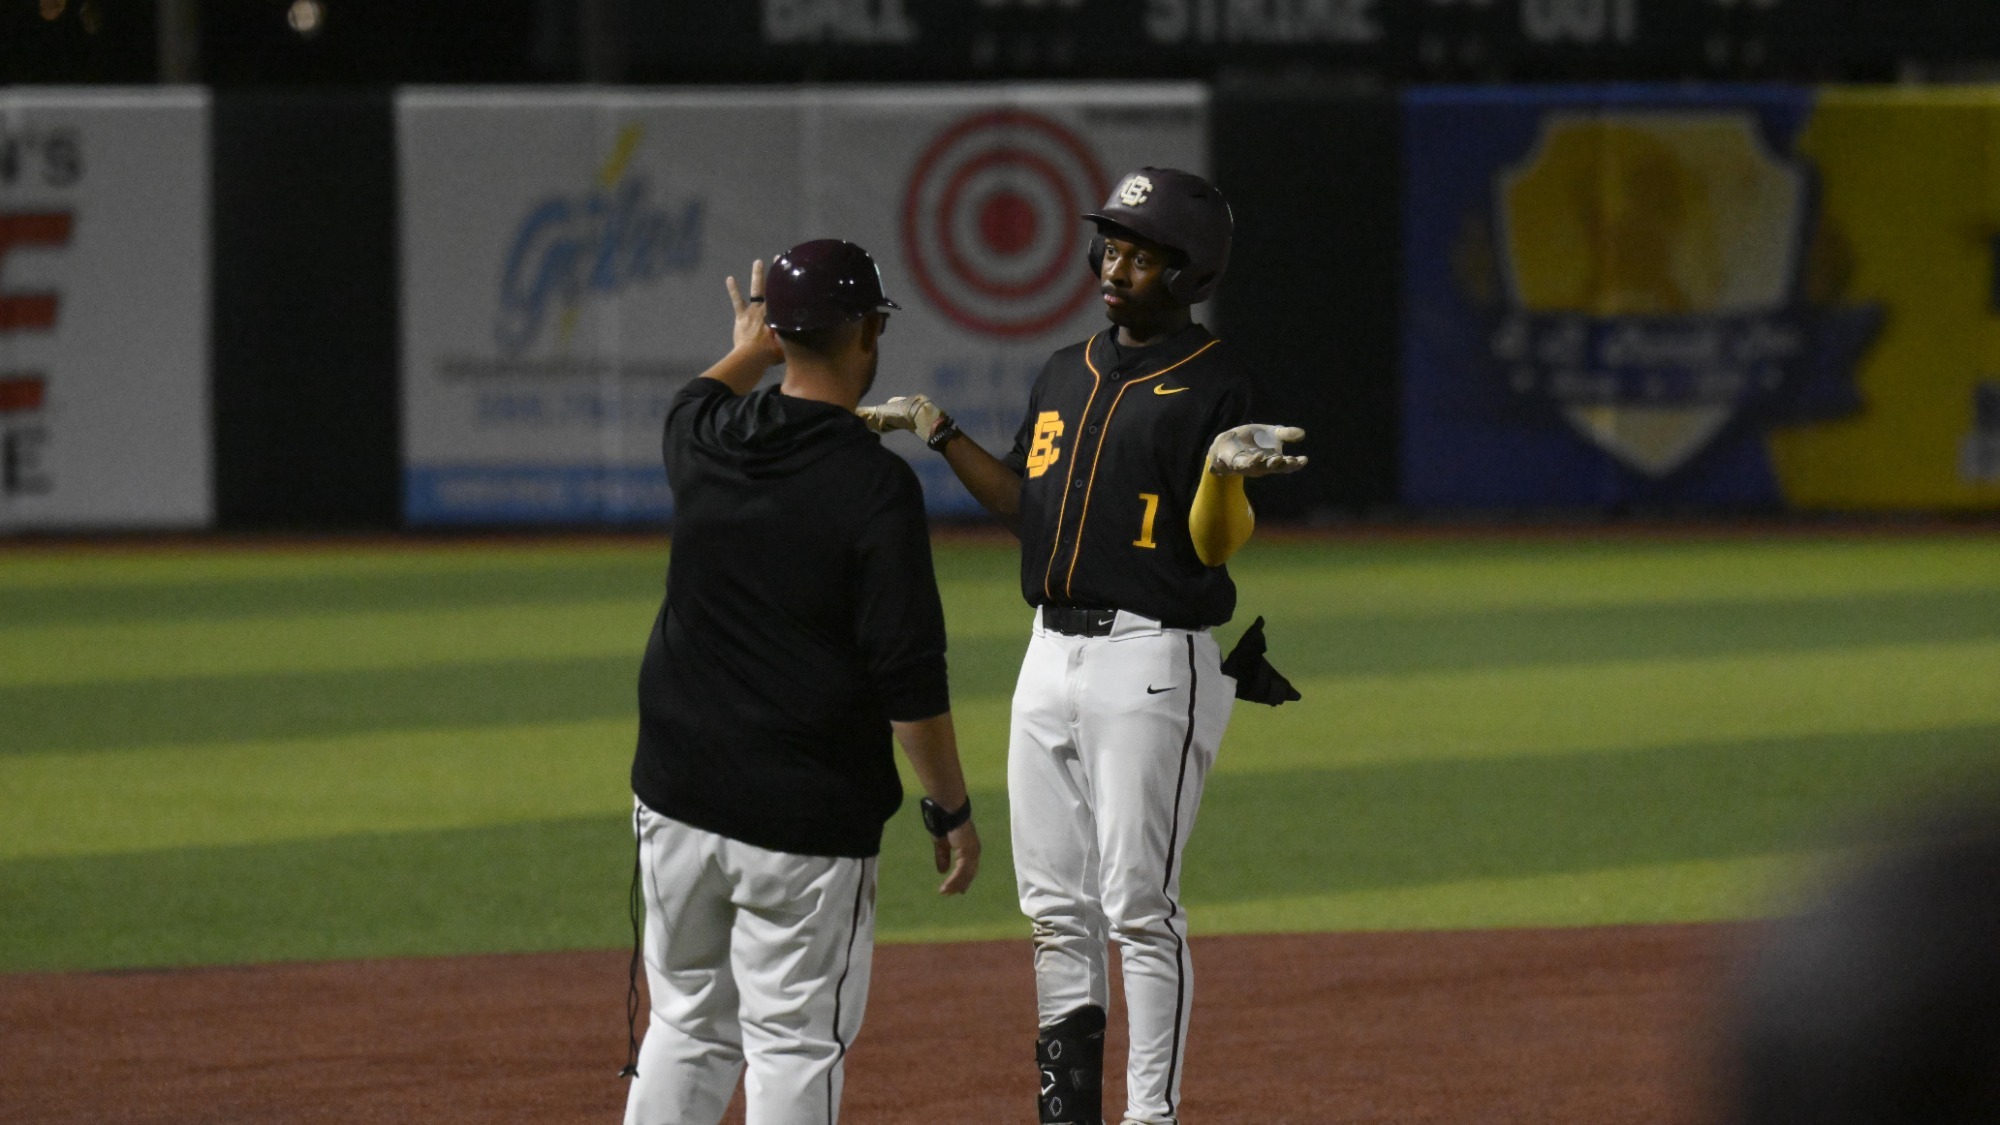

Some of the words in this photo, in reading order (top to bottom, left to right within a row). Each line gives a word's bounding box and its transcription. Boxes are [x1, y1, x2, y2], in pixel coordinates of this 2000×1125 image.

[761, 0, 918, 43] BALL
[1146, 0, 1384, 43] STRIKE
[1520, 0, 1638, 43] OUT
[1132, 492, 1159, 549] 1
